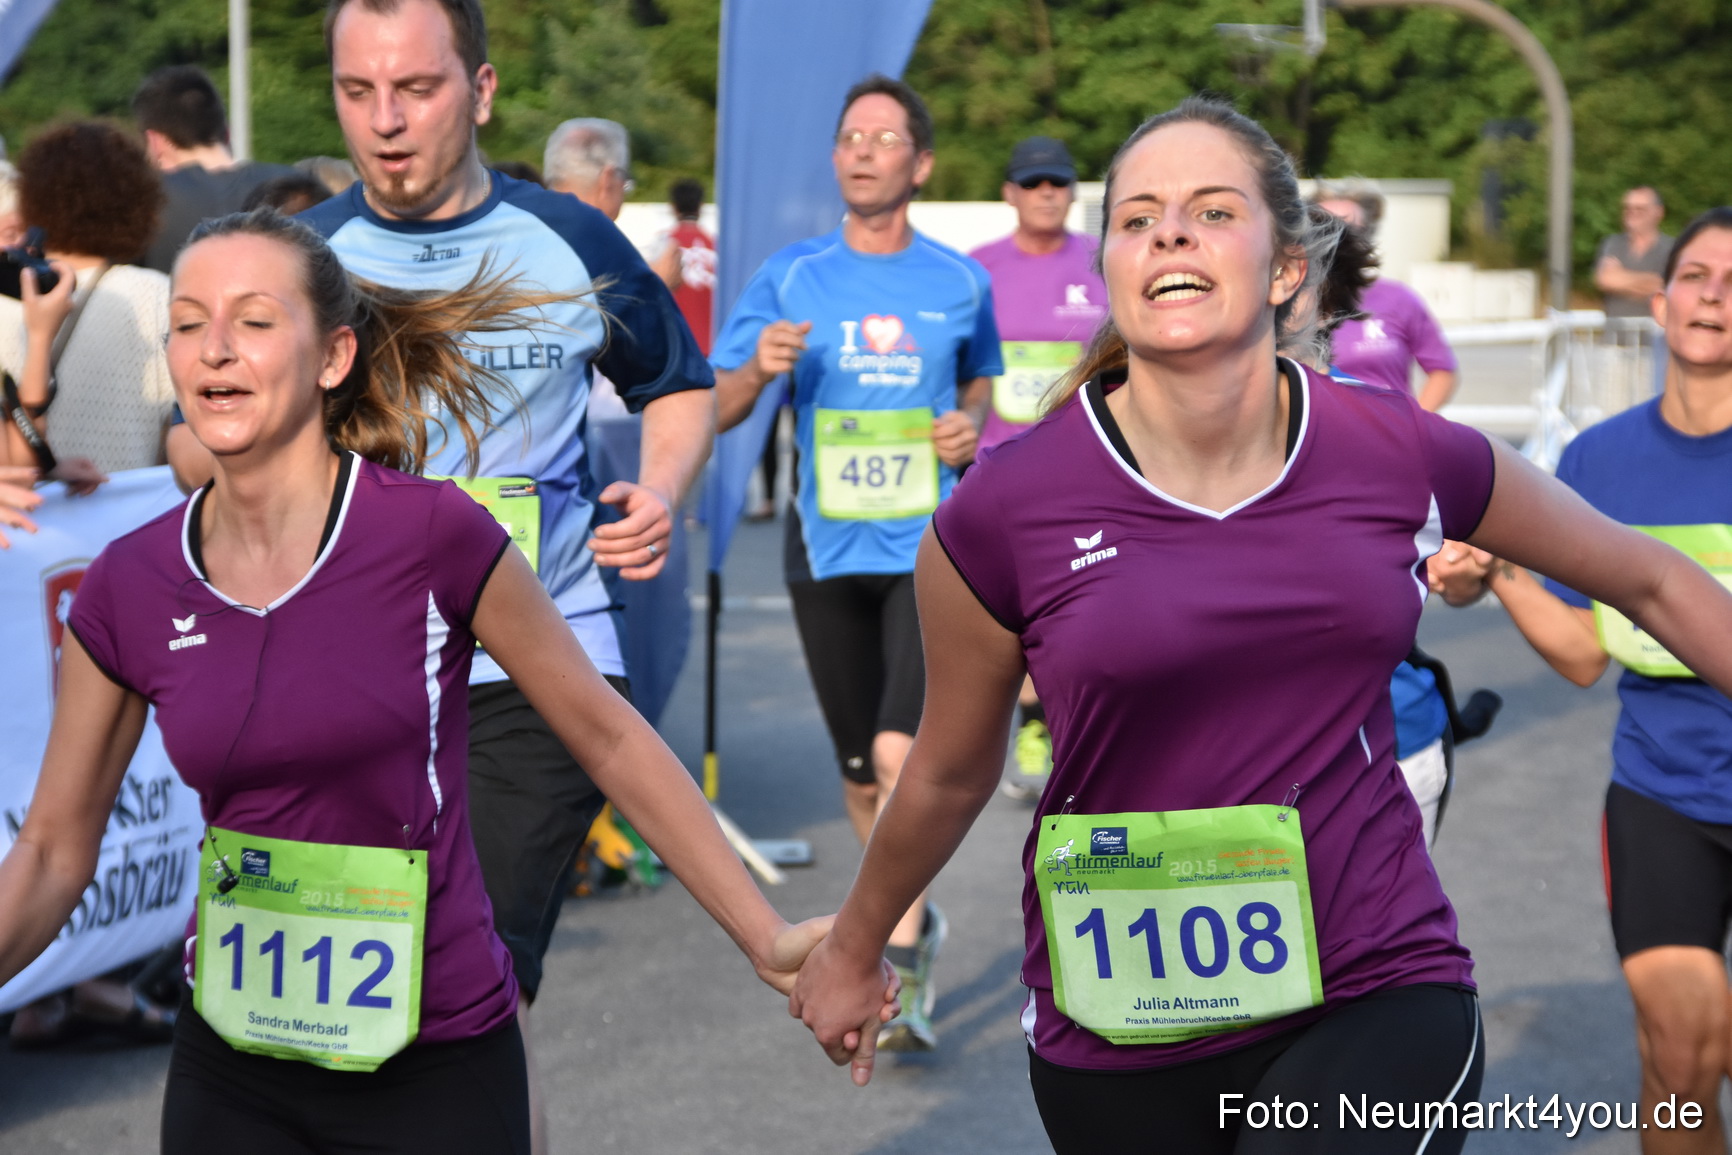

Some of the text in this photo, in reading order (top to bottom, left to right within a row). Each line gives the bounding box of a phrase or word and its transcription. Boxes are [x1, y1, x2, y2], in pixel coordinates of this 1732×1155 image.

[840, 321, 859, 352] I
[840, 454, 911, 487] 487
[1071, 547, 1118, 571] erima
[168, 633, 207, 651] erima
[1097, 832, 1123, 842] Fischer
[1075, 852, 1164, 869] firmenlauf
[1169, 859, 1217, 877] 2015
[300, 890, 345, 908] 2015
[1075, 902, 1288, 979] 1108
[220, 922, 394, 1009] 1112
[1133, 995, 1240, 1011] Julia Altmann
[248, 1011, 348, 1036] Sandra Merbald
[1125, 1013, 1252, 1025] Praxis Mühlenbruch/Kecke GbR
[245, 1029, 264, 1040] Praxis
[331, 1042, 348, 1051] GbR
